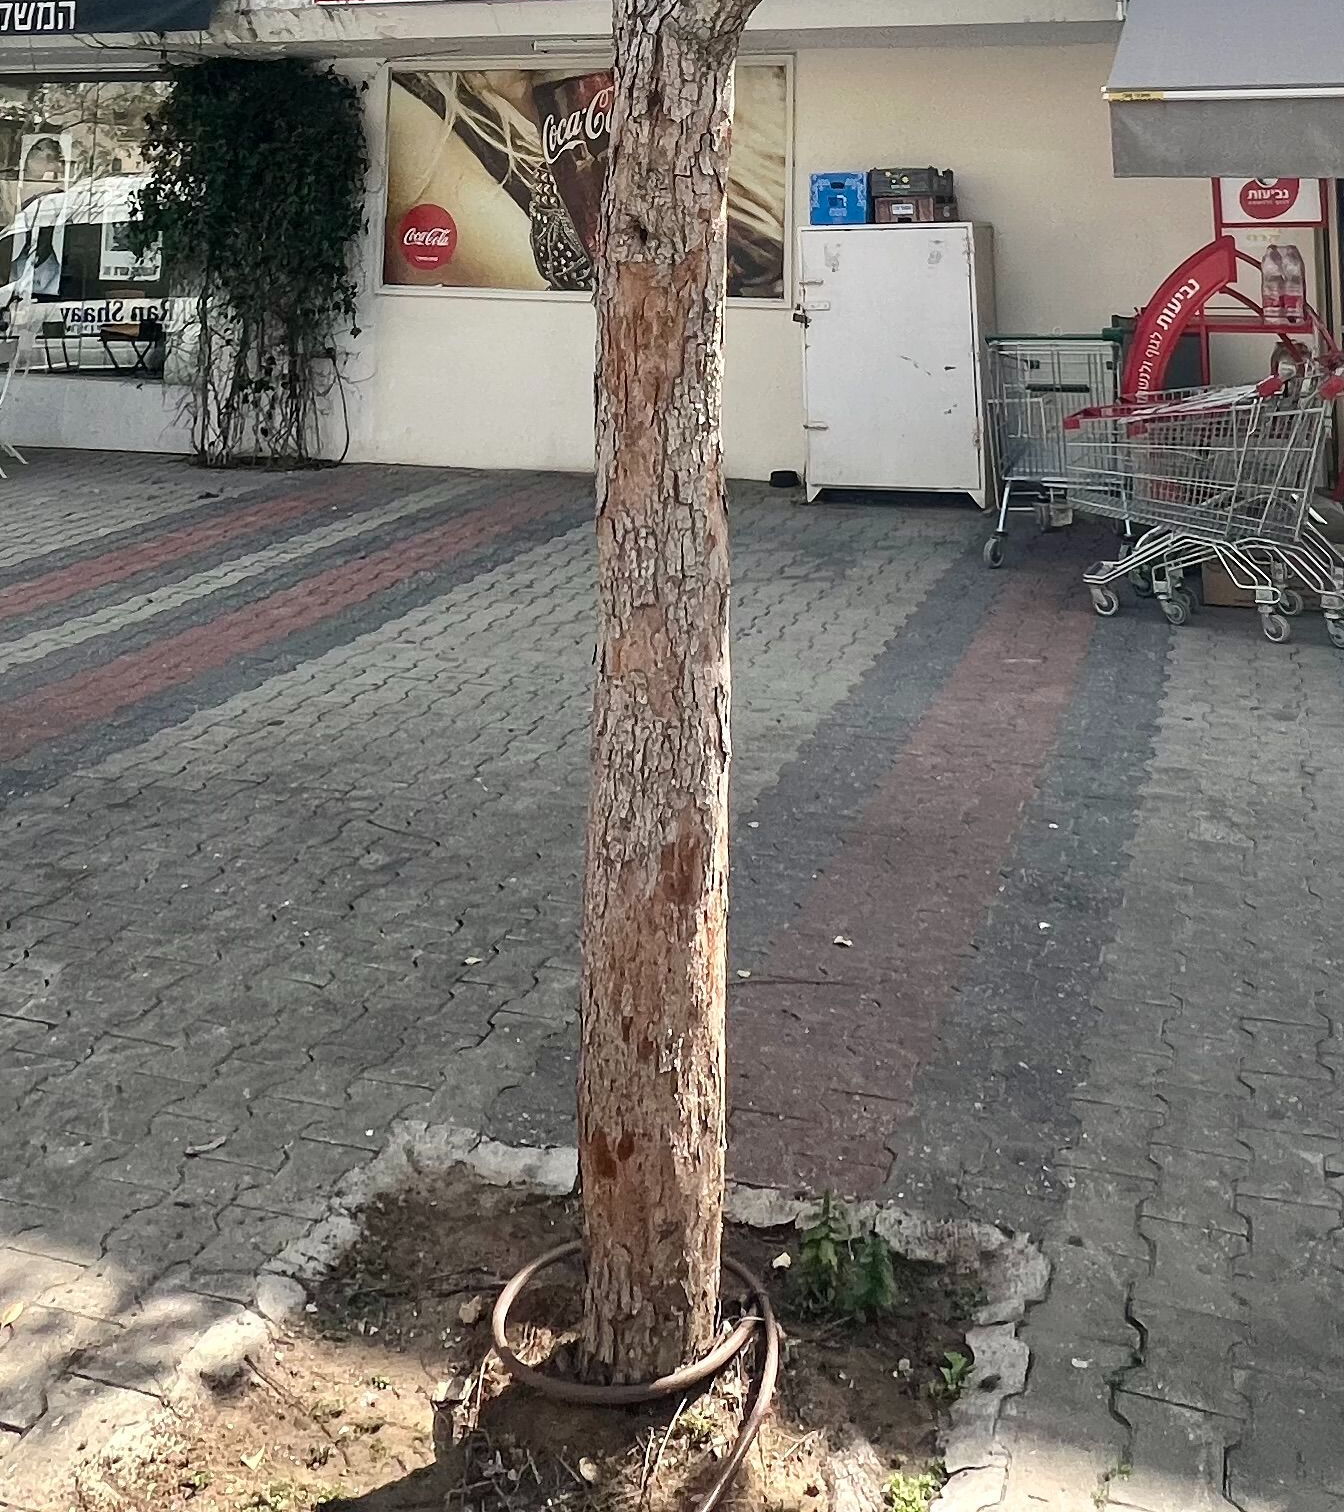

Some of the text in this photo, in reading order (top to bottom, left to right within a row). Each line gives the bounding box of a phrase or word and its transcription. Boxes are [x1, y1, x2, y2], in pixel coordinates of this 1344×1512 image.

[543, 85, 614, 165] Coca-C
[1247, 188, 1290, 200] נביעות
[403, 227, 452, 246] Coca-Cola
[1156, 278, 1201, 331] נביעות
